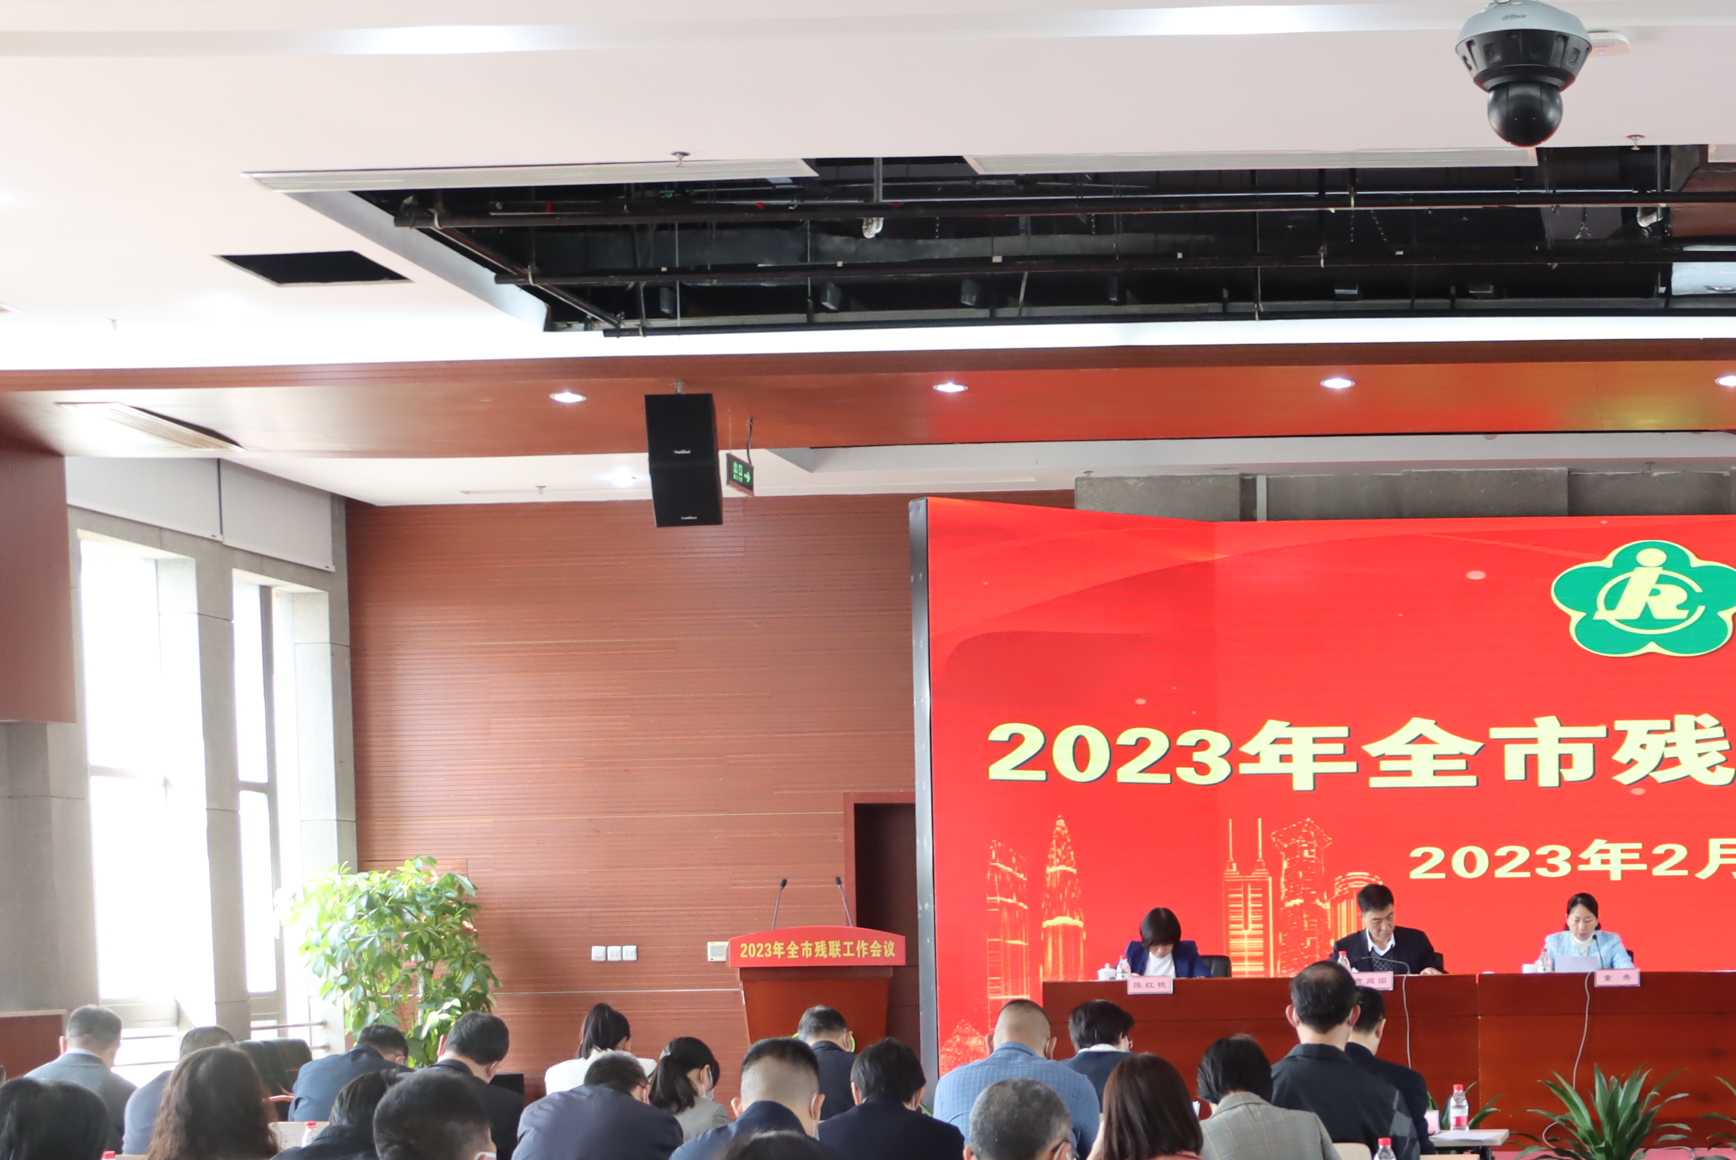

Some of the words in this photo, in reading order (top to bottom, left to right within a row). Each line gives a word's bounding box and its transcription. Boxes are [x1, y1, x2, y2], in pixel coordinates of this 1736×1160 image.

[740, 940, 896, 959] 2023年全市残联工作会议
